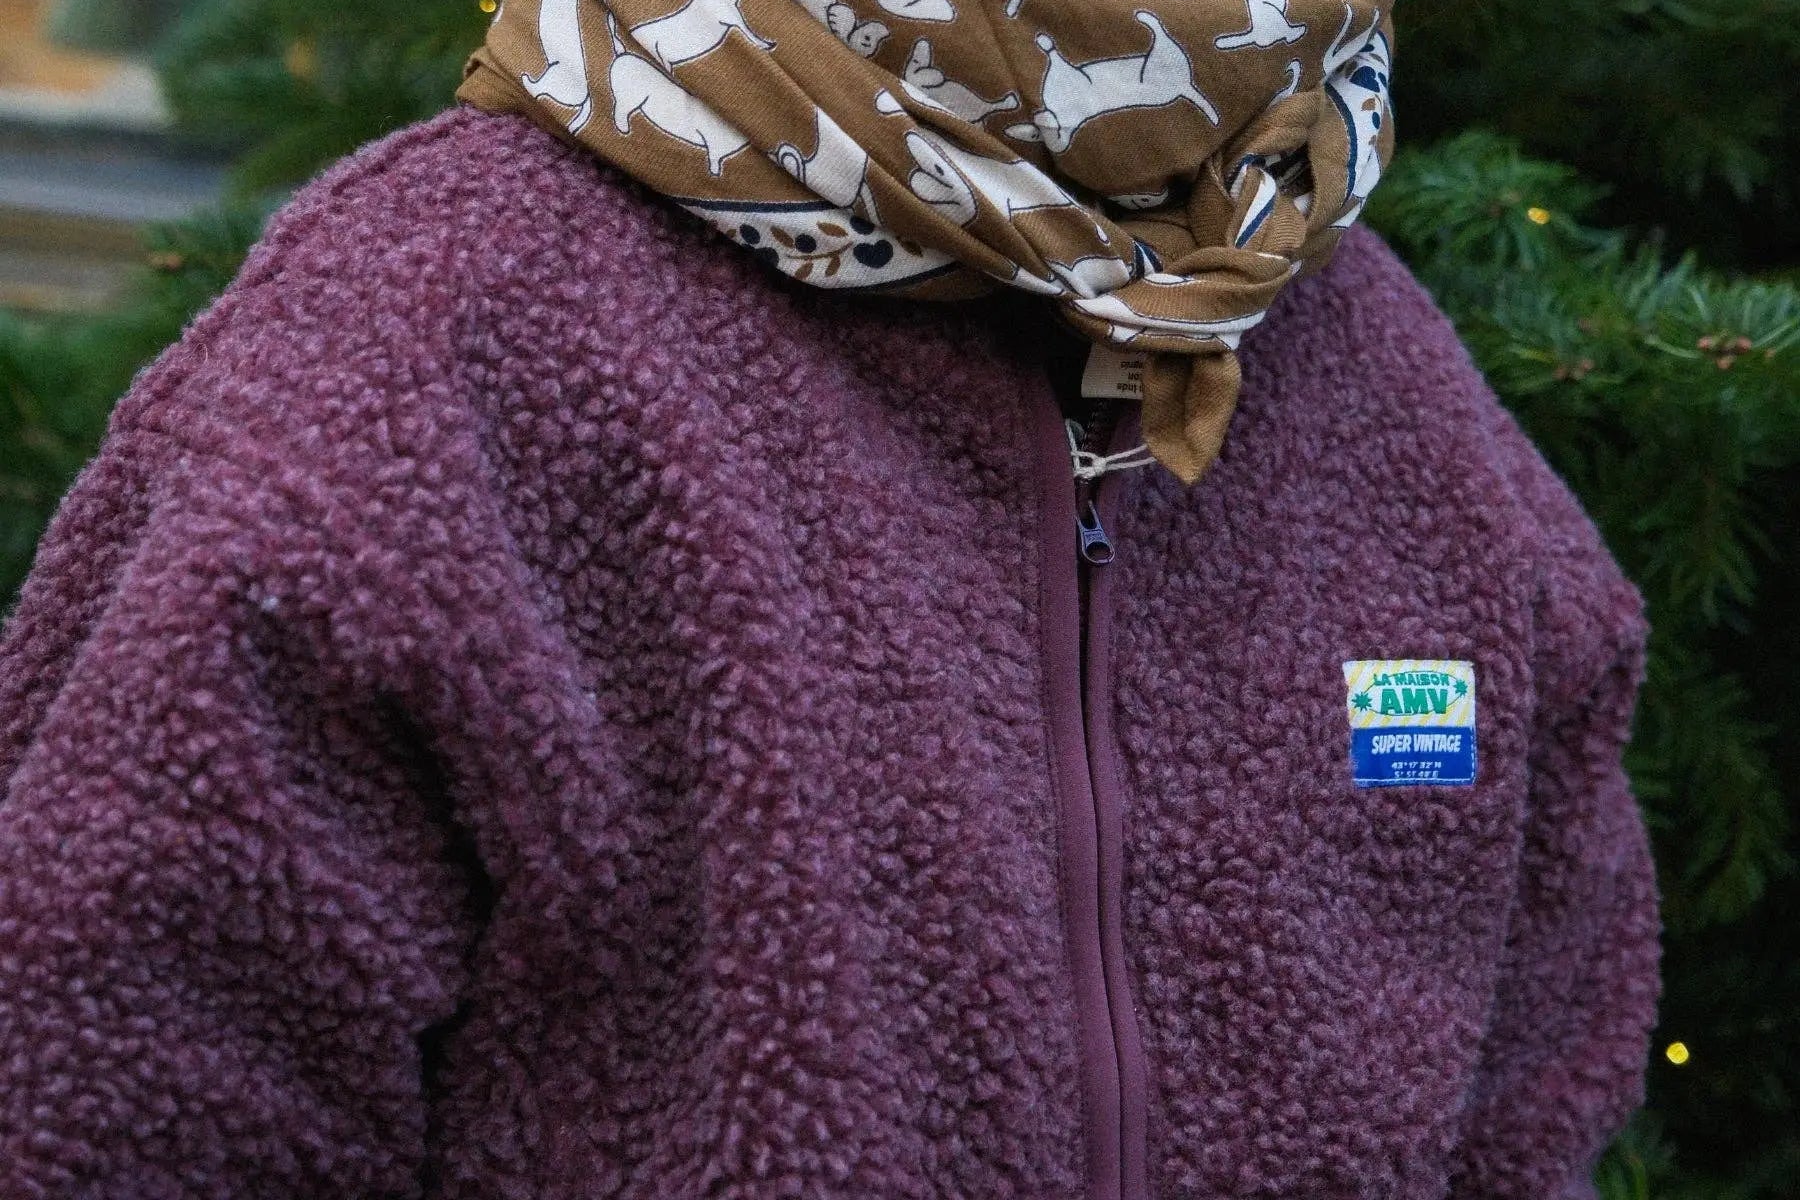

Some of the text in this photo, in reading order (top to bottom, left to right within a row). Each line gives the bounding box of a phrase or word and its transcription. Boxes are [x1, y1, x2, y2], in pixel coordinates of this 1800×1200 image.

[1374, 672, 1450, 686] LA MAISON
[1380, 688, 1448, 715] AMV
[1371, 734, 1461, 754] SUPER VINTAGE
